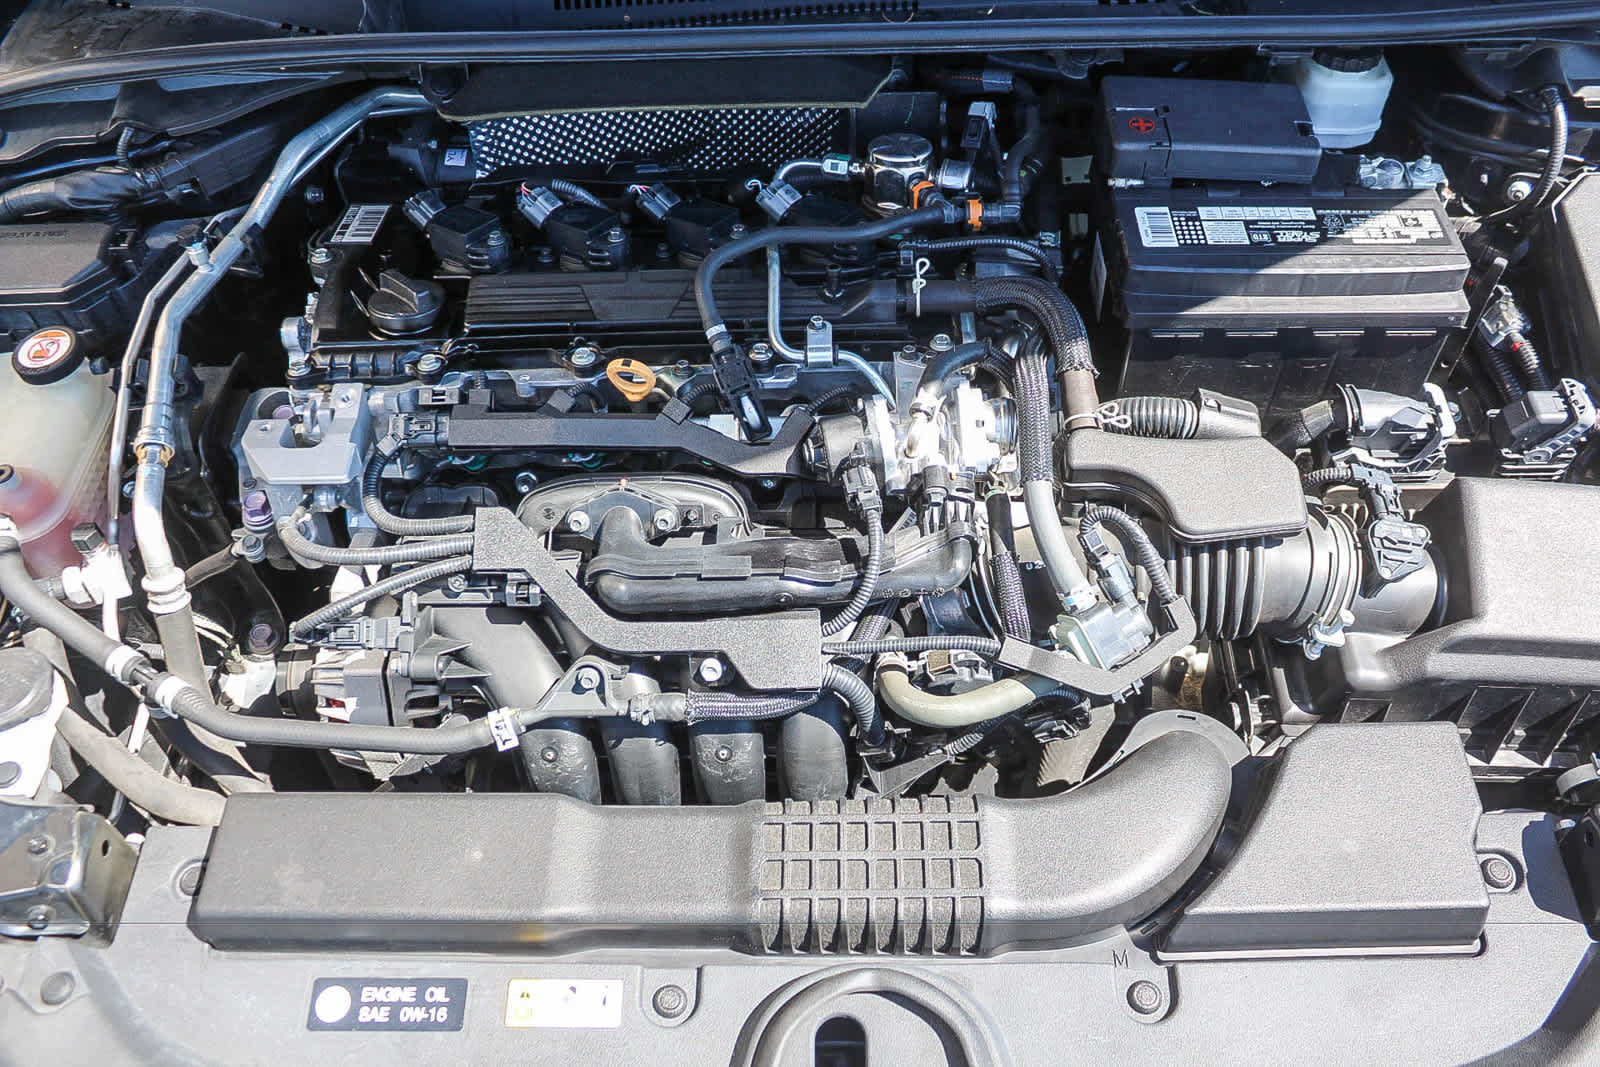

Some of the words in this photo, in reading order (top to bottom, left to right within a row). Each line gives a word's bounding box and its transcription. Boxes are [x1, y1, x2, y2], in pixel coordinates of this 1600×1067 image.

[1112, 949, 1128, 968] M
[360, 986, 417, 1003] ENGINE
[424, 986, 450, 1003] OIL
[358, 1005, 391, 1023] SAE
[399, 1006, 448, 1023] 0W-16
